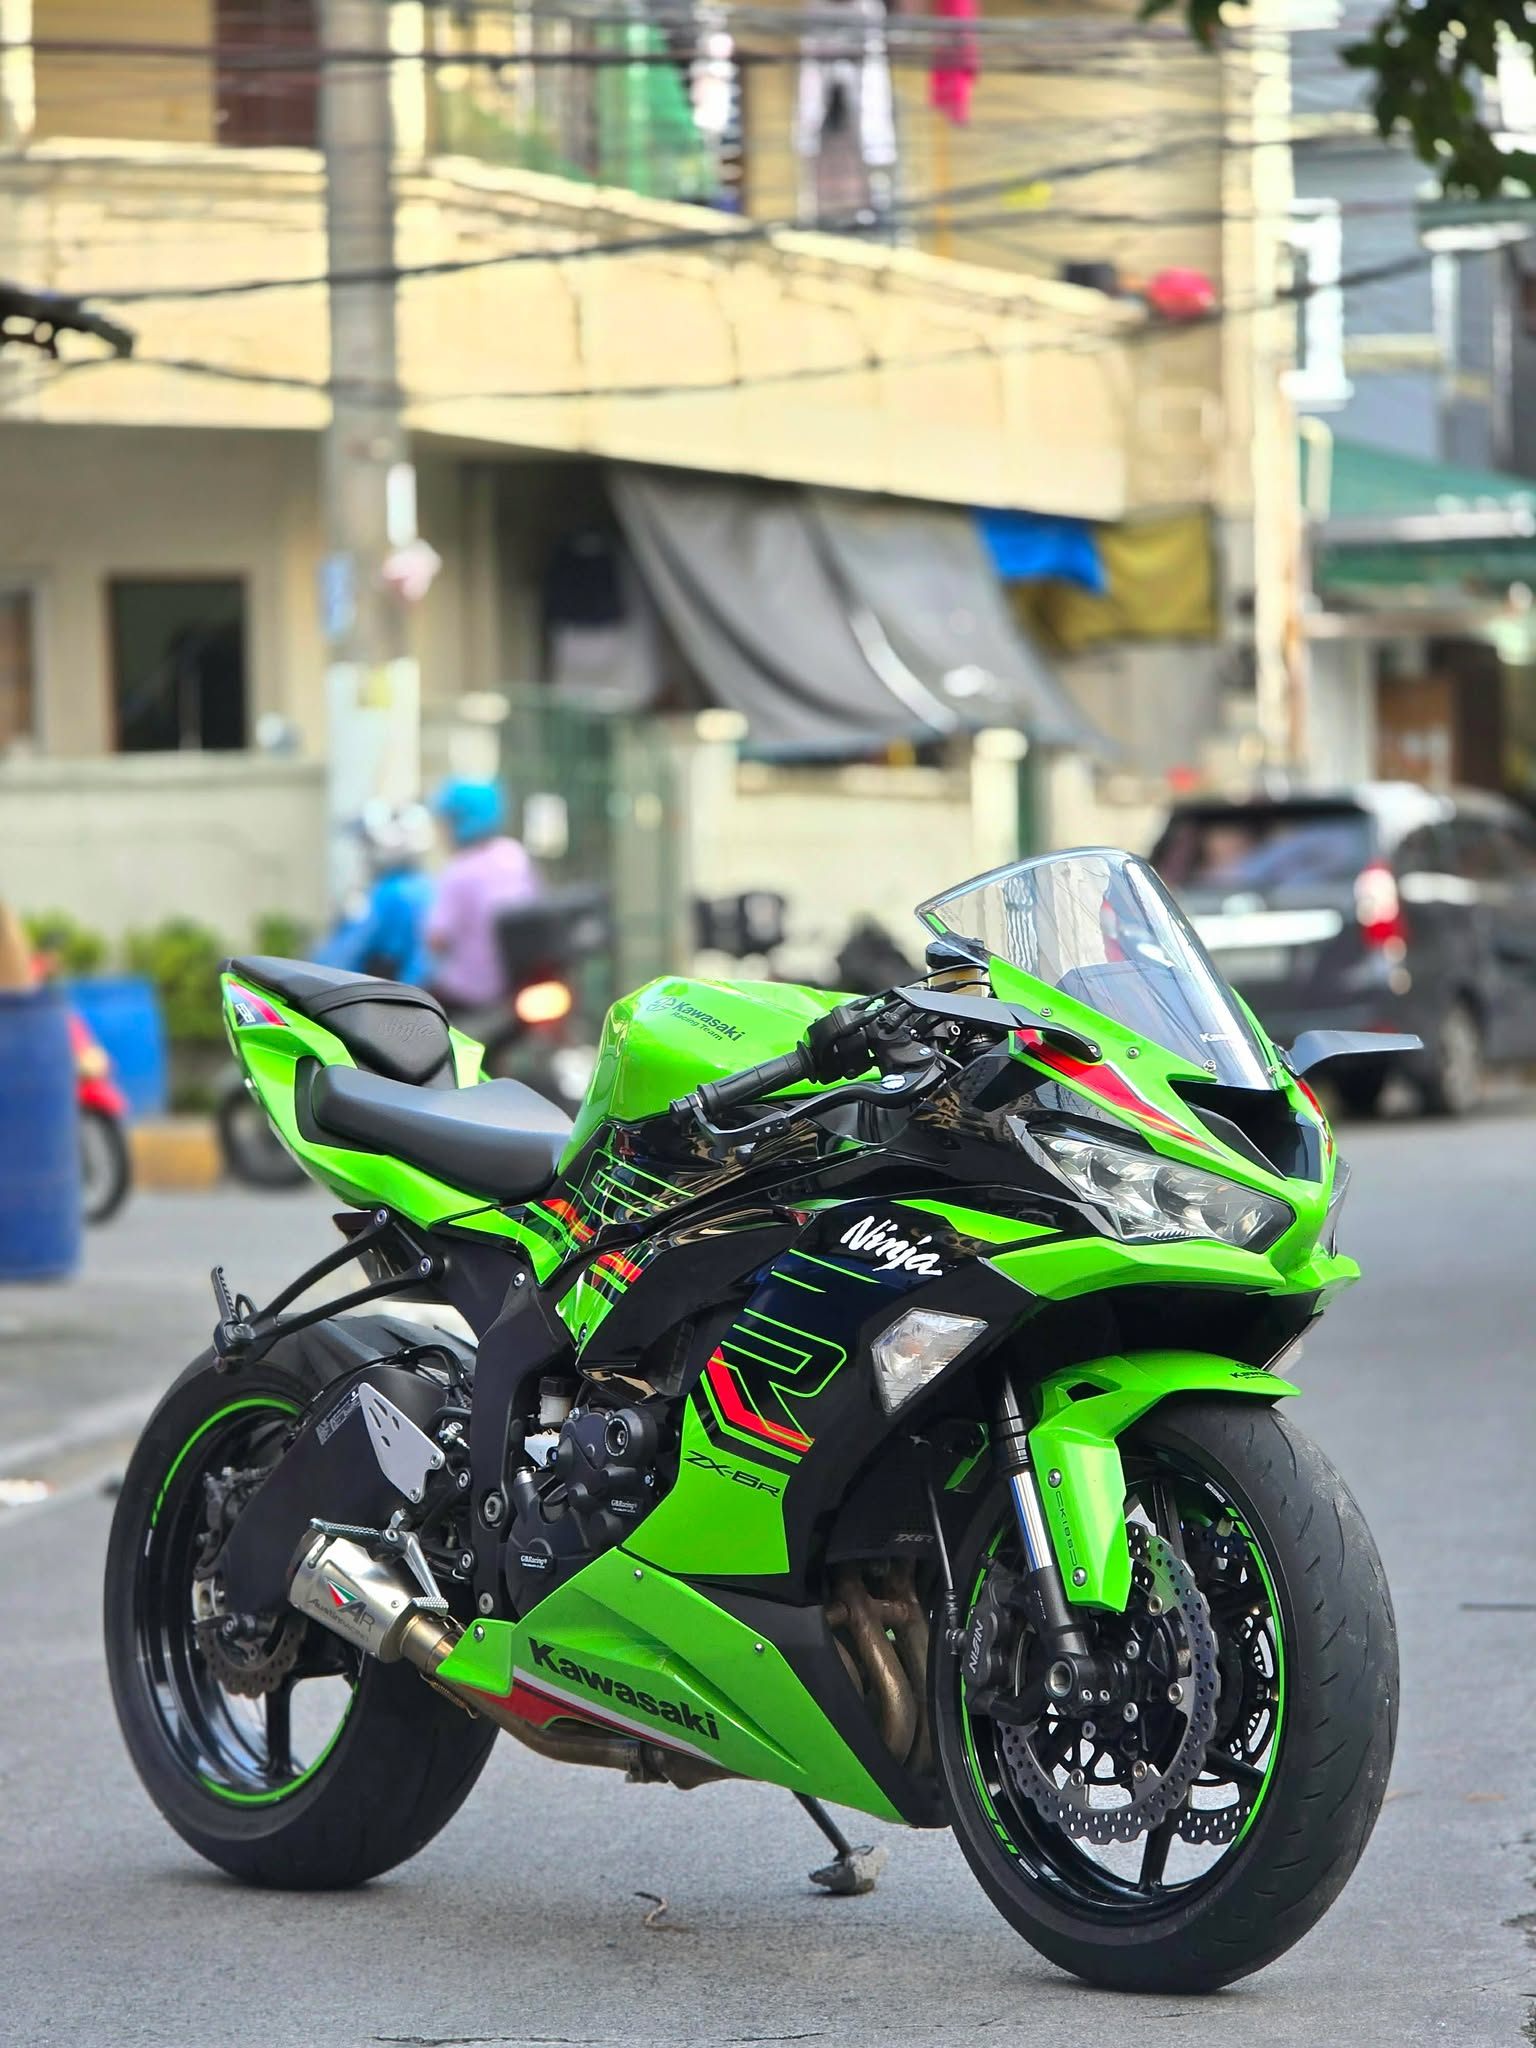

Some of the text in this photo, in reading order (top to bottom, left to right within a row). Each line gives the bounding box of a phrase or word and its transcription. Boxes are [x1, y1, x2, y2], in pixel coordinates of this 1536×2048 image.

[671, 1011, 724, 1041] Racing Team
[672, 1001, 746, 1041] Kawasaki
[840, 1215, 943, 1276] Ninja
[683, 1449, 781, 1498] ZX-6R
[528, 1636, 721, 1741] Kawasaki
